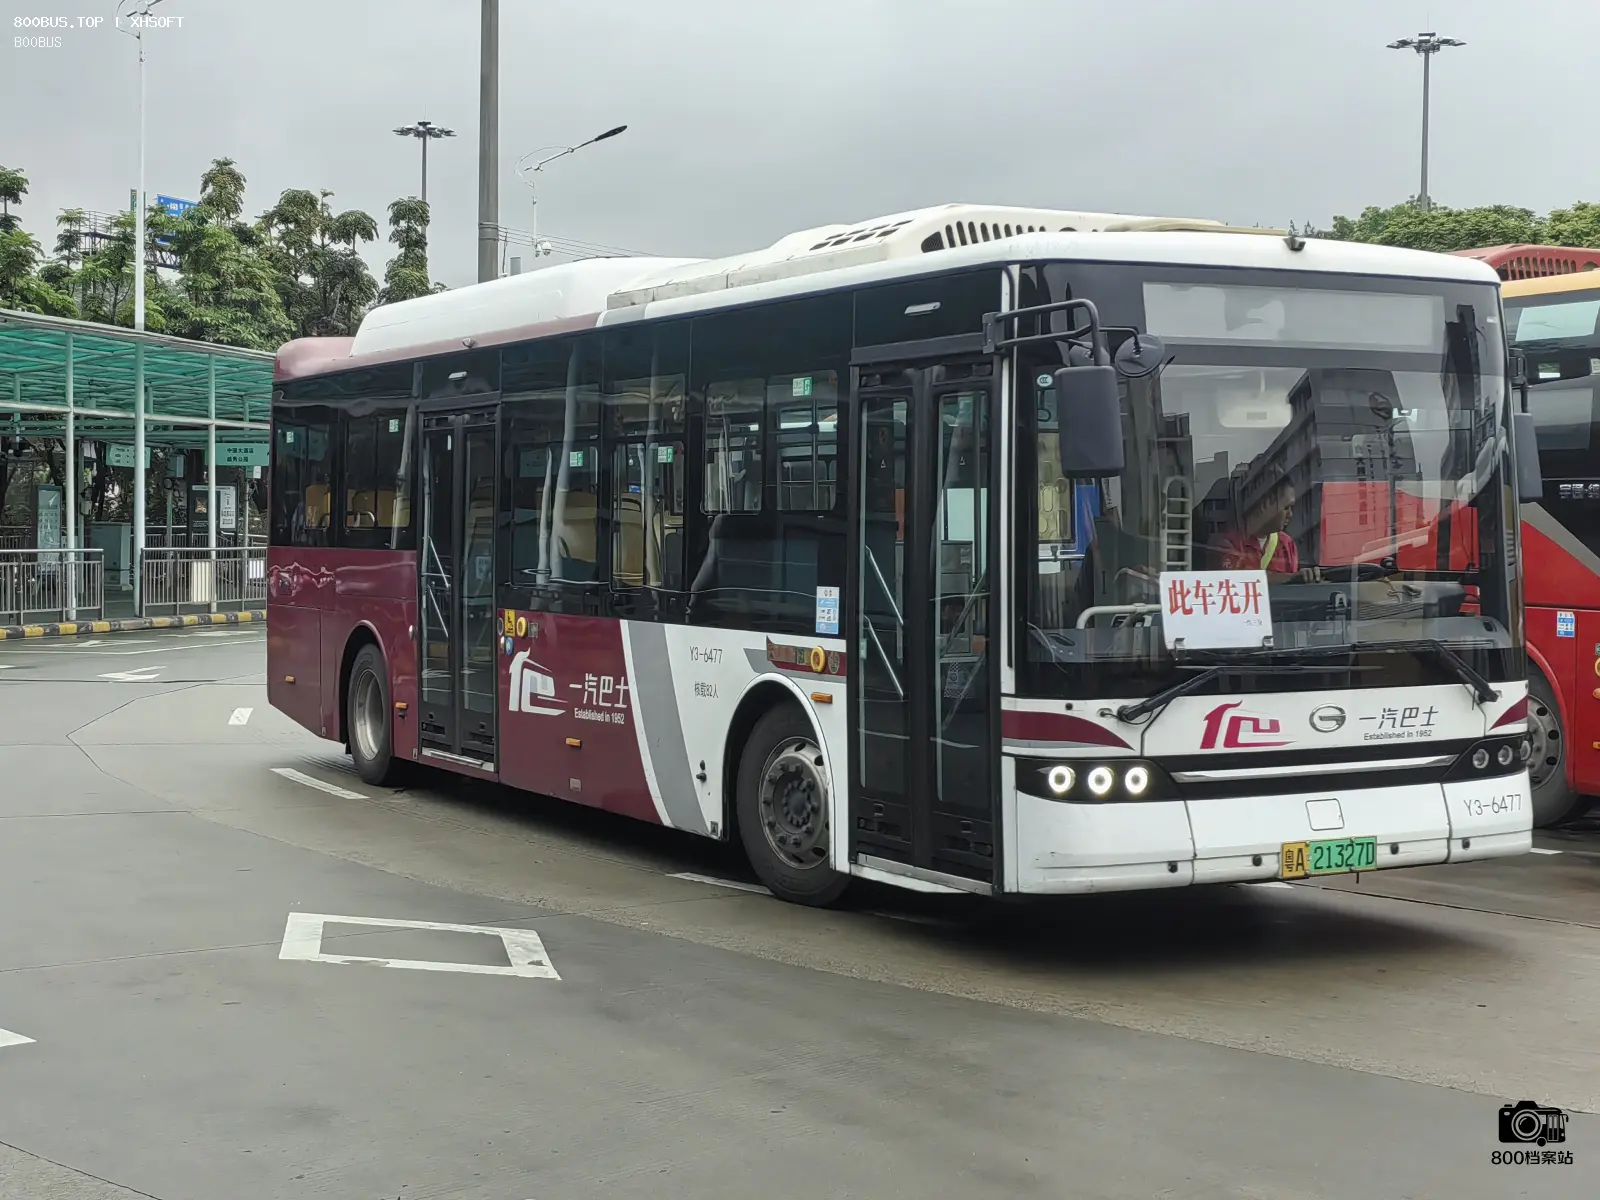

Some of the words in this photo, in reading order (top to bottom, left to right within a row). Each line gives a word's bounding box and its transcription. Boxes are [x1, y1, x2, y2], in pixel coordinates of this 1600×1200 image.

[1168, 579, 1263, 616] 此车先开
[690, 645, 723, 664] Y3-6477
[569, 672, 629, 708] 一汽巴士
[574, 707, 605, 722] Established
[604, 711, 611, 723] in
[611, 712, 625, 725] 1952
[1359, 705, 1439, 729] 一汽巴士
[1363, 731, 1406, 741] Established
[1406, 730, 1414, 738] in
[1415, 729, 1433, 738] 1952
[1463, 793, 1522, 817] Y3-6477
